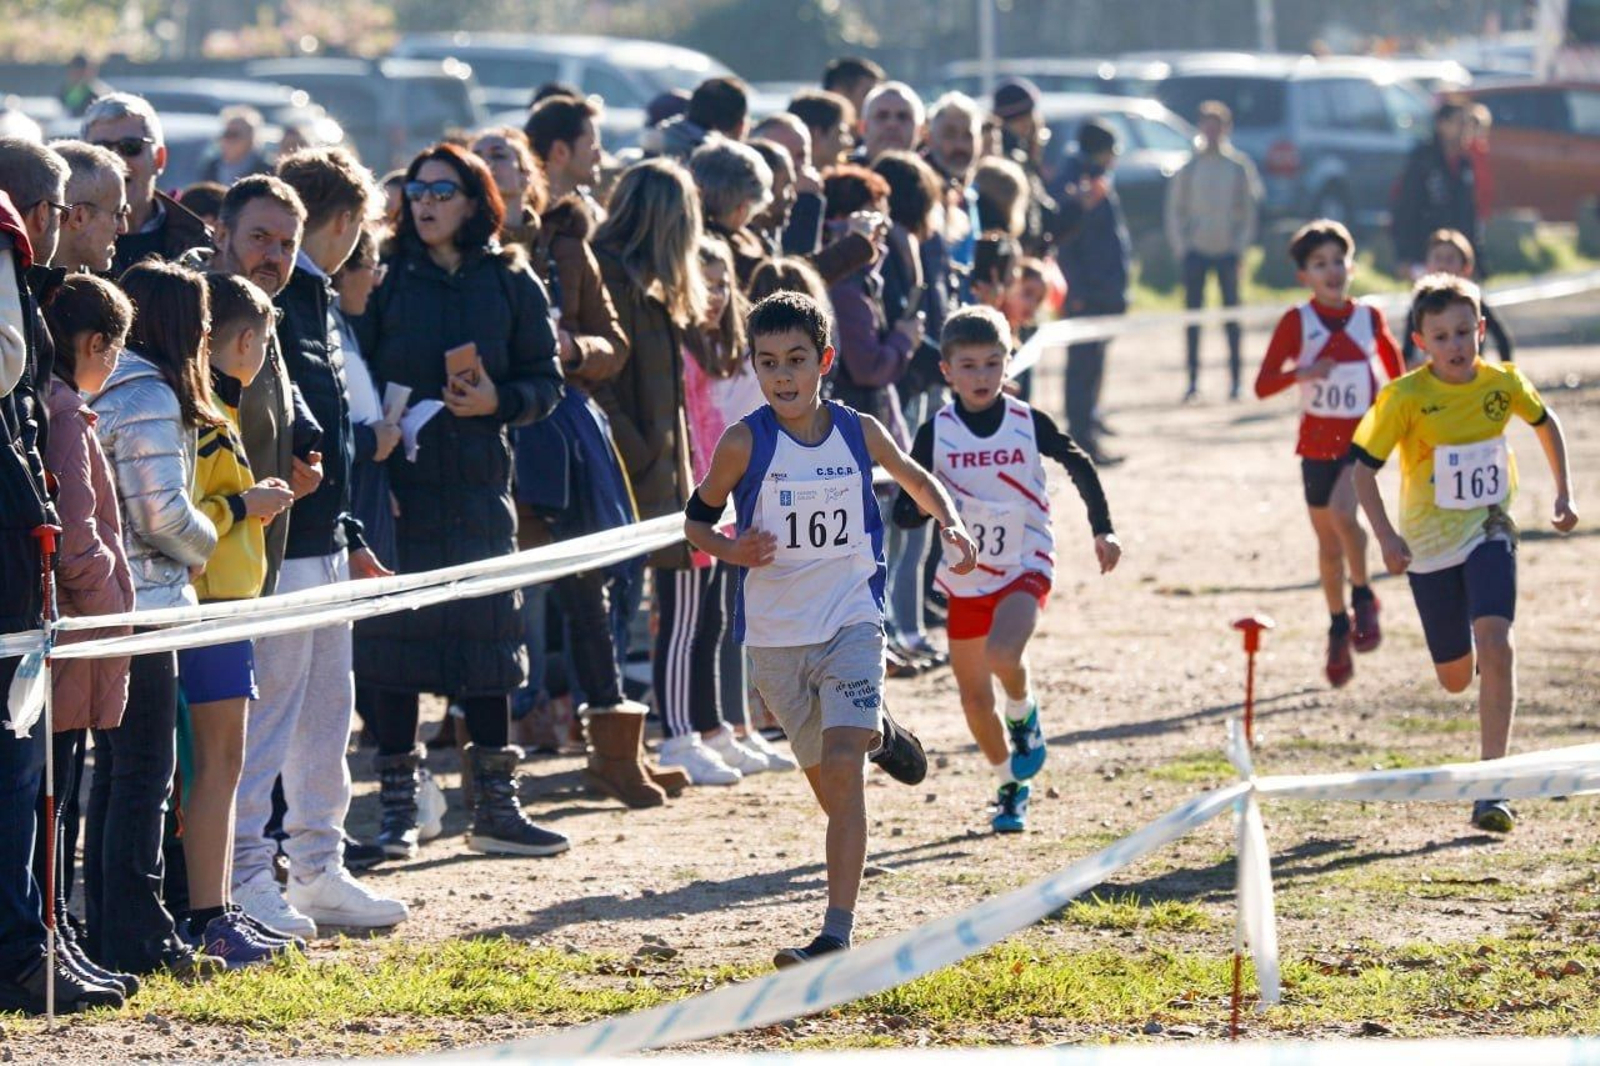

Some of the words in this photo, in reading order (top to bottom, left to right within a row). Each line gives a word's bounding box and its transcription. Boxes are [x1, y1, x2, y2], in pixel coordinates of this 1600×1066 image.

[1312, 383, 1356, 410] 206
[947, 449, 1025, 469] TREGA
[1453, 464, 1499, 501] 163
[785, 509, 848, 549] 162
[962, 519, 1006, 557] 33
[848, 678, 869, 689] time
[859, 685, 876, 696] ride
